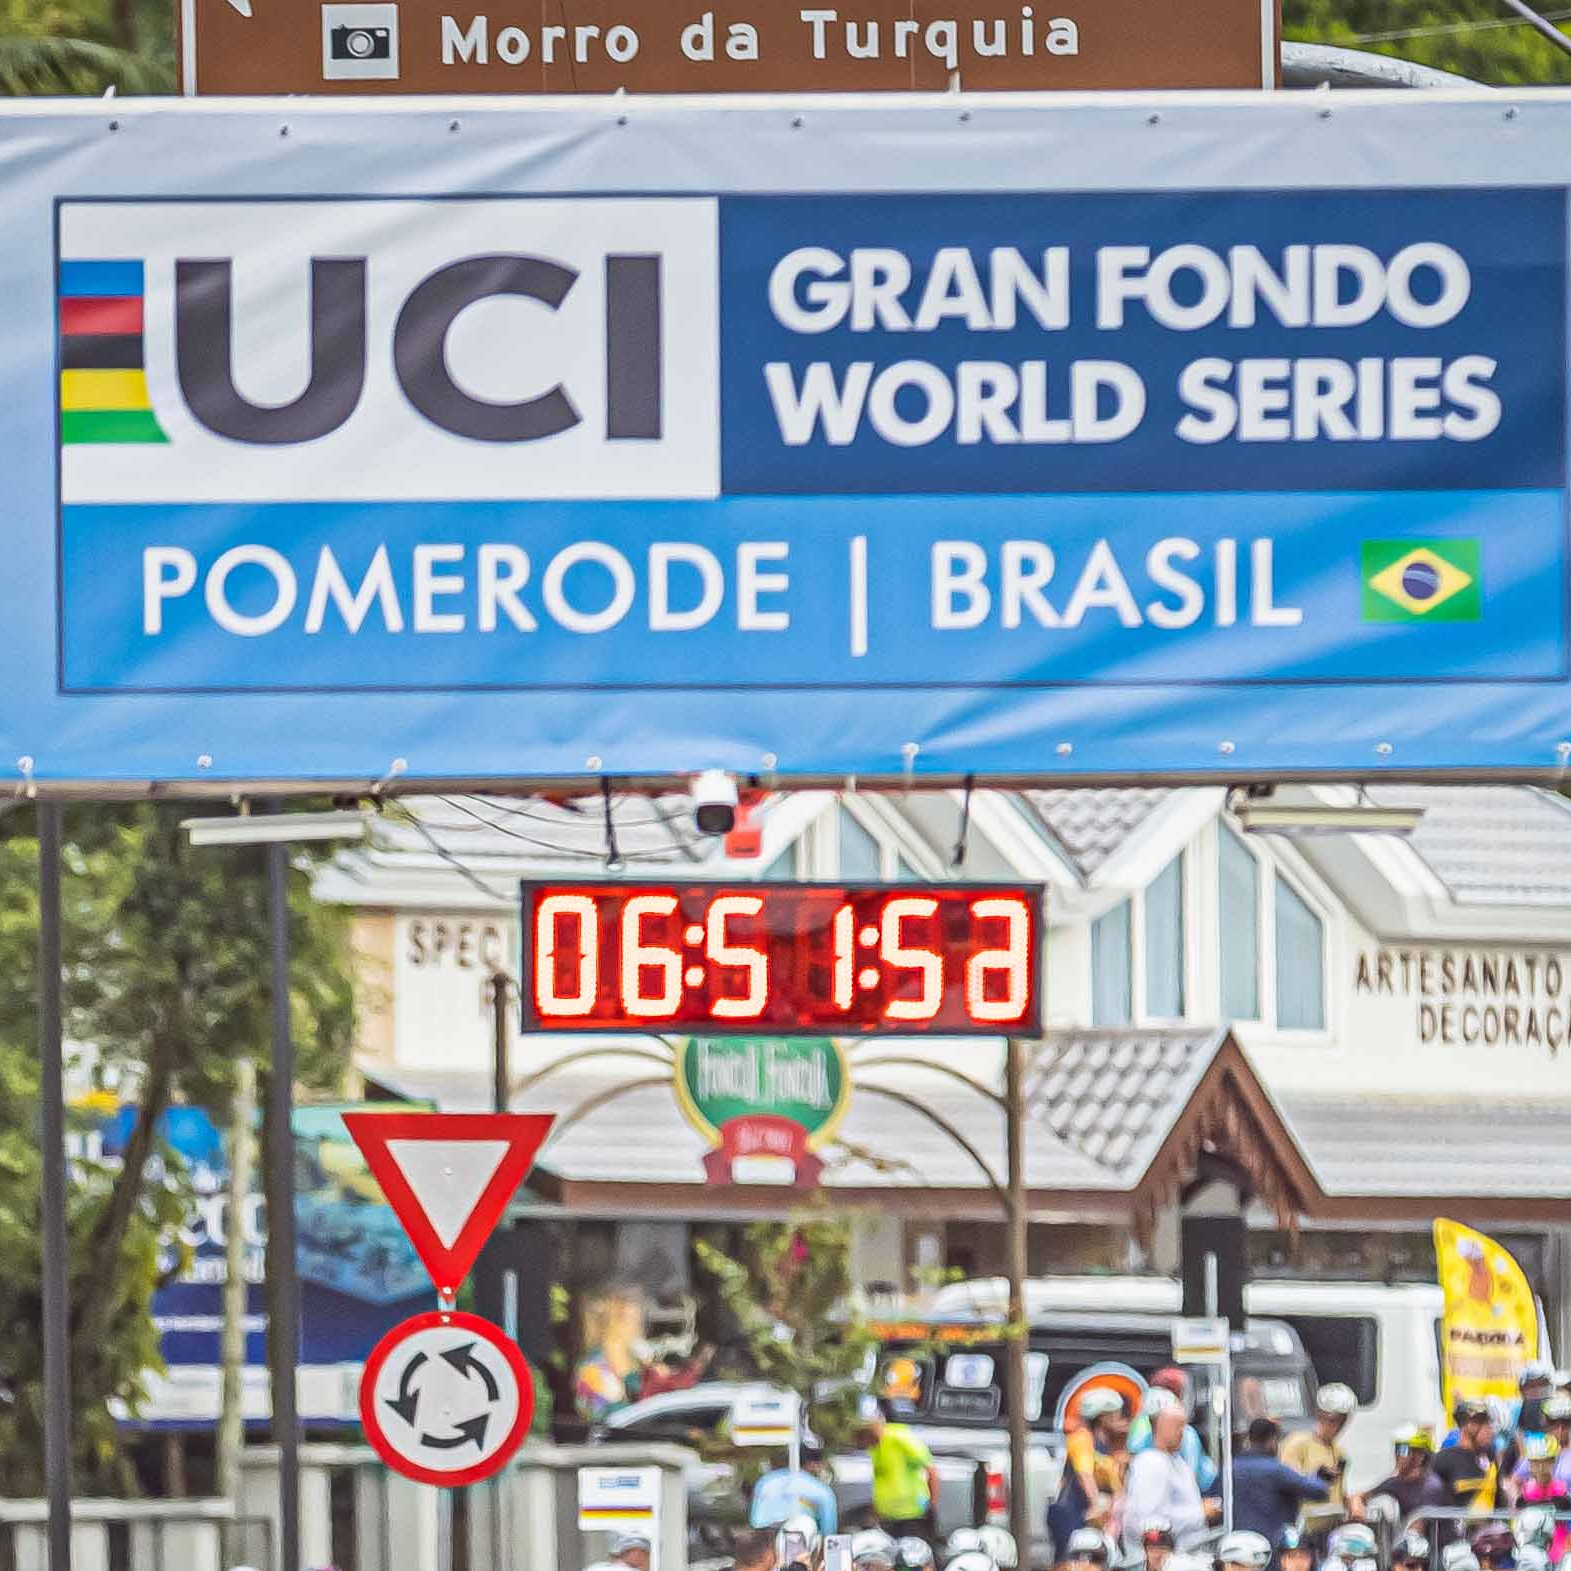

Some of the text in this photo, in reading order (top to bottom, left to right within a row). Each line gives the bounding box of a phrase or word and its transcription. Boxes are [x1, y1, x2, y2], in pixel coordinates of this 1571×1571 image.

[441, 5, 1079, 70] Morro da Turquia
[768, 242, 1471, 333] GRAN FONDO
[174, 253, 663, 447] UCI
[764, 355, 1502, 446] WORLD SERIES
[142, 540, 791, 637] POMERODE
[930, 536, 1307, 631] BRASIL
[1353, 948, 1567, 996] ARTESANATO
